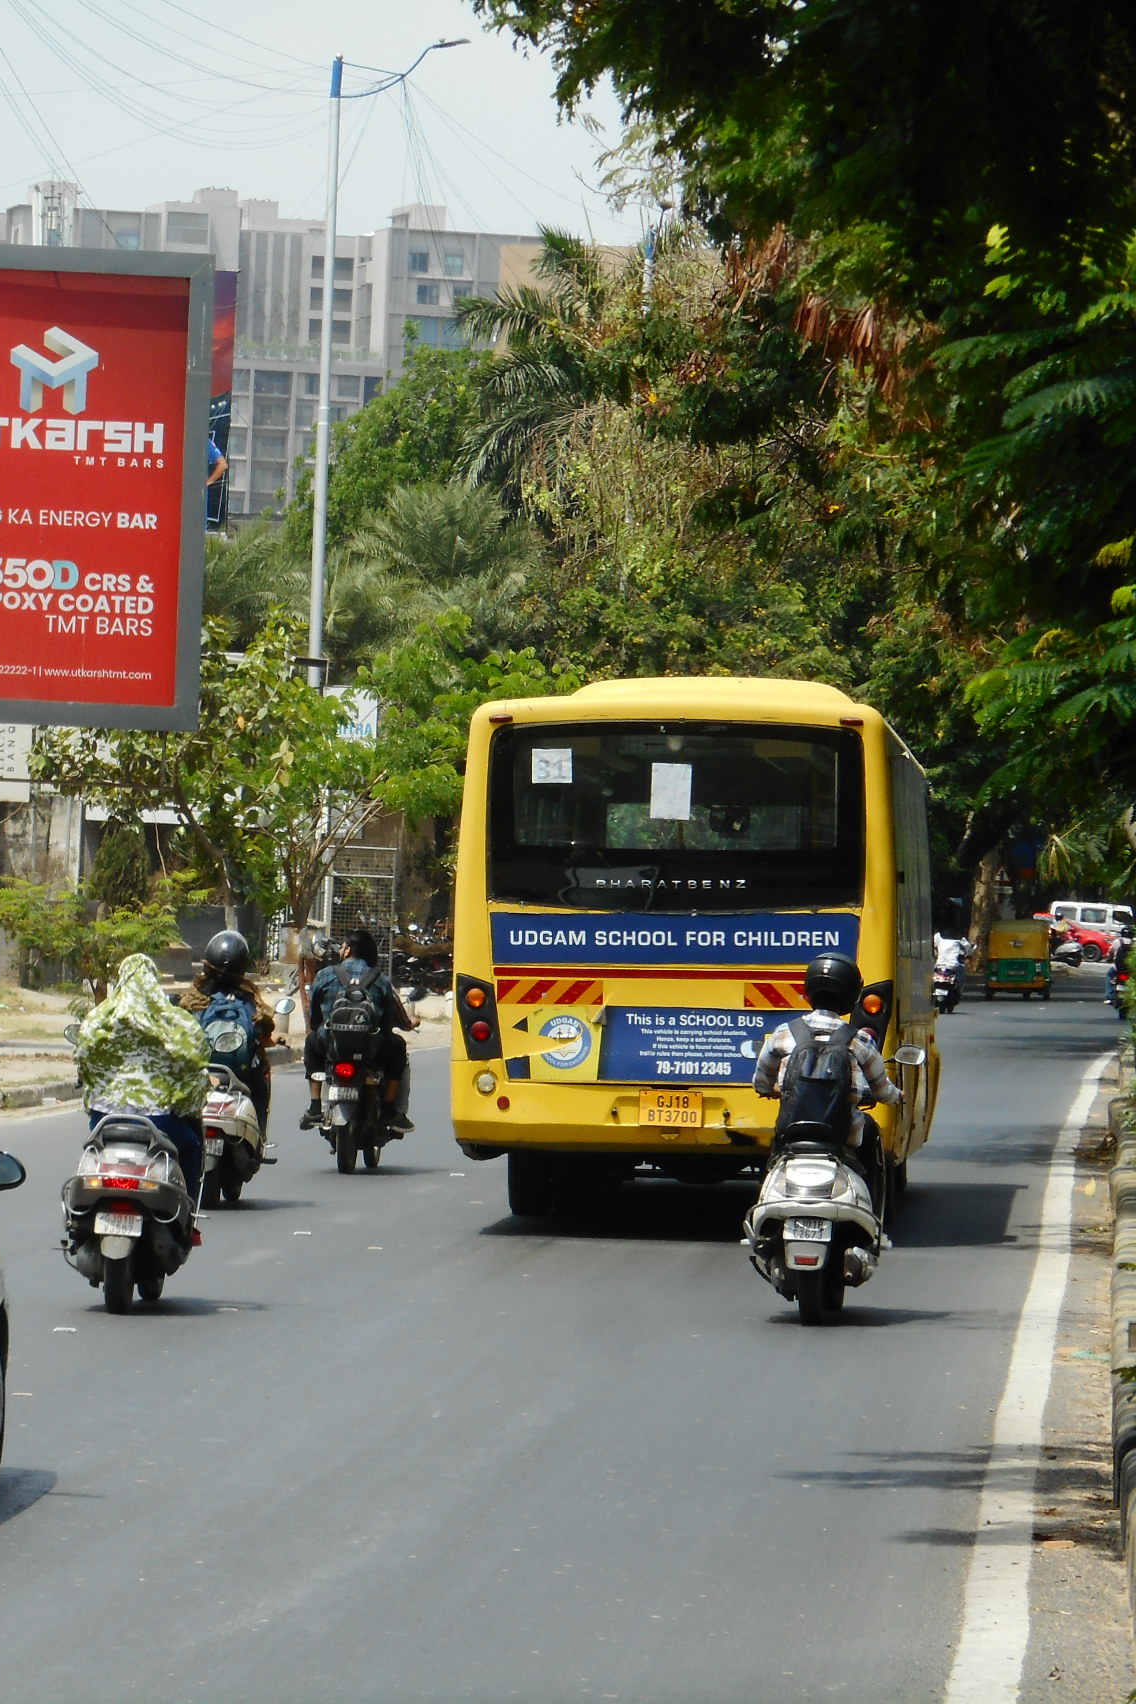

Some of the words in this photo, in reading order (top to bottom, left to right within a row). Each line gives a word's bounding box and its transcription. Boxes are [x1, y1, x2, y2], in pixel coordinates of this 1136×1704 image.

[74, 456, 107, 467] TMT
[117, 457, 164, 469] BARS
[8, 508, 33, 525] KA
[39, 509, 113, 528] ENERGY
[117, 512, 158, 530] BAR
[84, 574, 131, 593] CRS
[136, 575, 155, 593] &
[58, 594, 154, 615] COATED
[45, 615, 90, 635] TMT
[95, 616, 153, 637] BARS
[44, 667, 152, 681] www.utkarshtmt.com
[537, 758, 566, 780] 31
[596, 879, 747, 889] BHARATBENZ
[509, 930, 587, 946] UDGAM
[594, 930, 678, 946] SCHOOL
[686, 931, 726, 946] FOR
[733, 931, 840, 947] CHILDREN
[626, 1013, 652, 1025] This
[655, 1014, 665, 1025] is
[668, 1017, 676, 1025] a
[679, 1014, 734, 1027] SCHOOL
[738, 1015, 764, 1027] BUS
[701, 1061, 732, 1075] 2345
[657, 1095, 690, 1109] GJ18
[648, 1110, 698, 1124] BT3700
